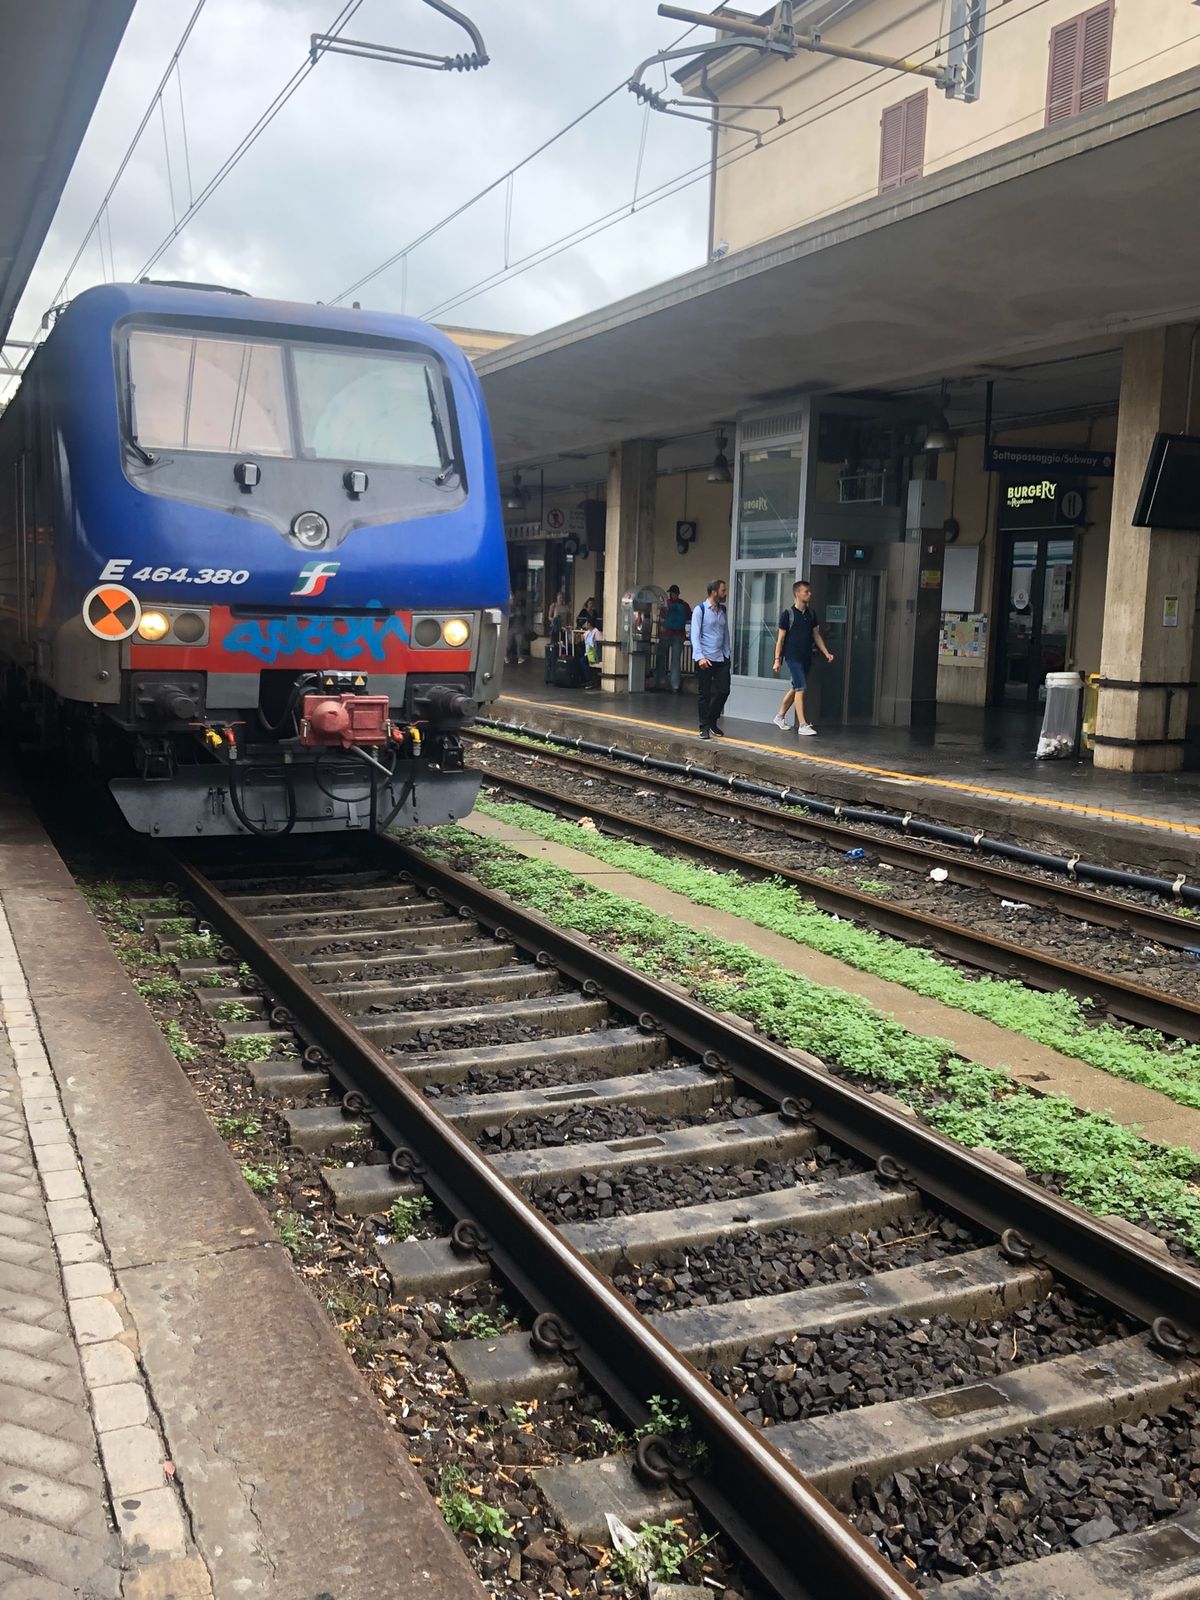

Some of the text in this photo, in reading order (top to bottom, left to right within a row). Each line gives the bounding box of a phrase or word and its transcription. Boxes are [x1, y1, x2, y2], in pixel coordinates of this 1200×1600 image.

[1008, 481, 1057, 499] BURGERY
[98, 558, 250, 585] E 464.380
